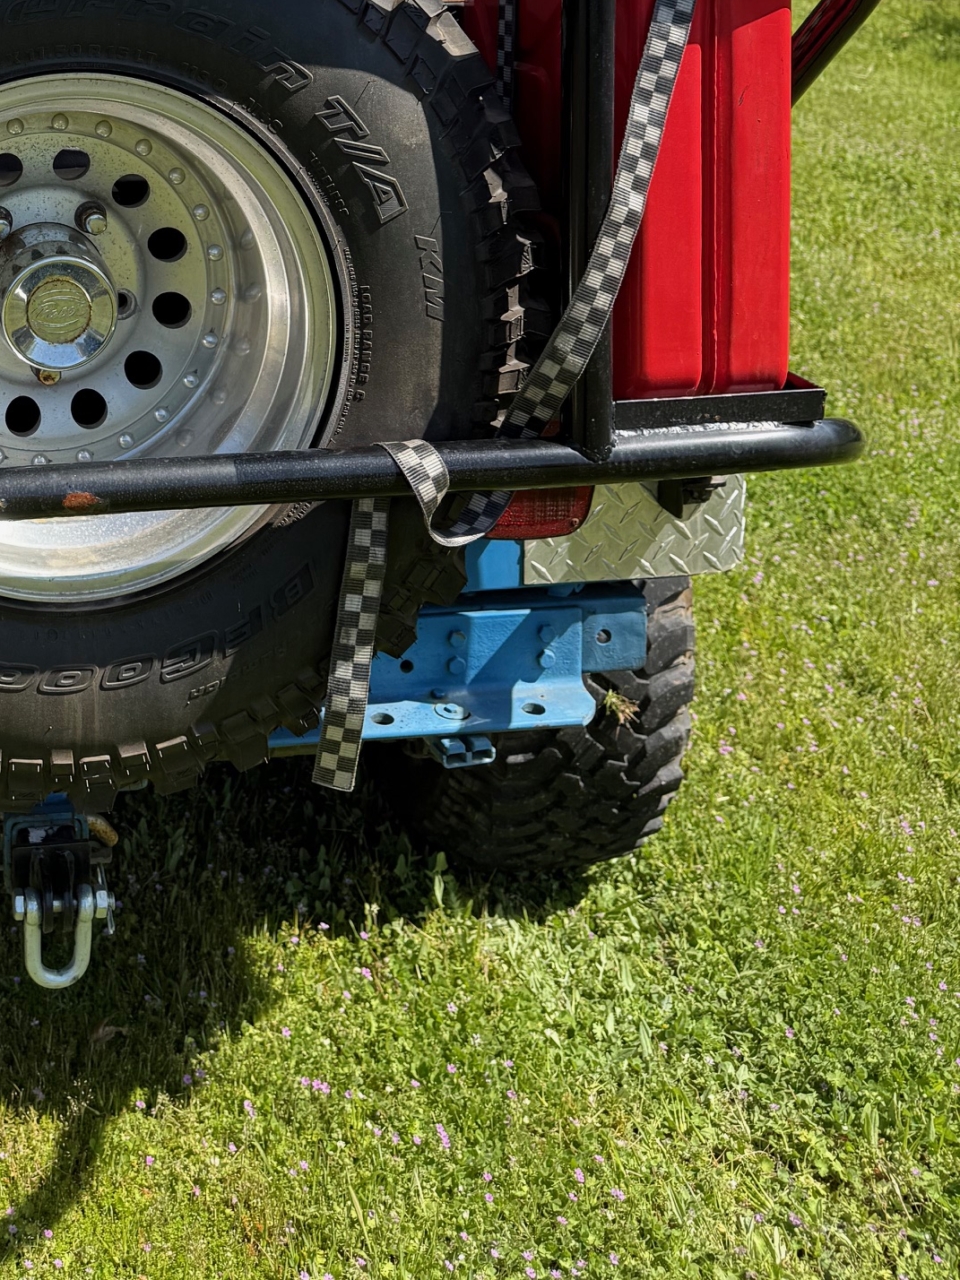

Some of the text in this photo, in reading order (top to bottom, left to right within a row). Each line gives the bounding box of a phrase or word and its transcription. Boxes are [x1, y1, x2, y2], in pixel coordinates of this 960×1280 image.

[314, 94, 410, 223] T/A
[415, 233, 445, 321] KM
[358, 283, 374, 323] LOAD
[357, 329, 373, 383] RANGE
